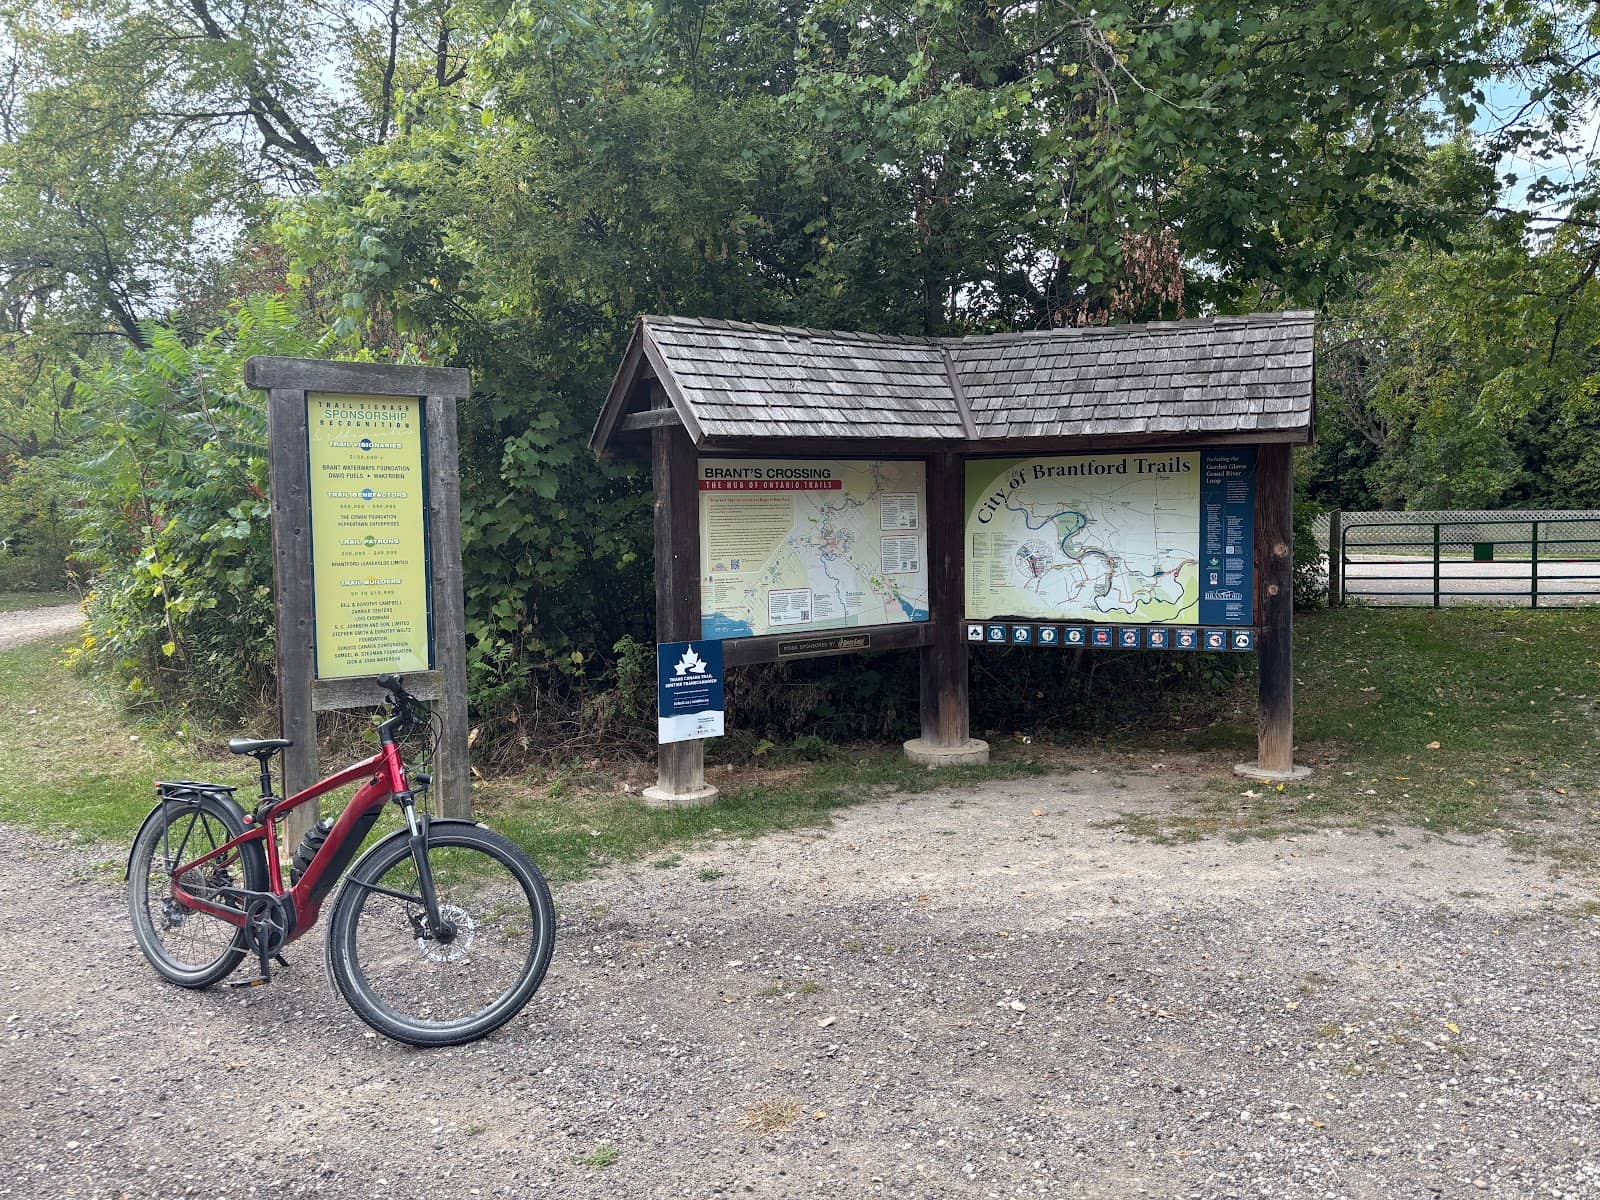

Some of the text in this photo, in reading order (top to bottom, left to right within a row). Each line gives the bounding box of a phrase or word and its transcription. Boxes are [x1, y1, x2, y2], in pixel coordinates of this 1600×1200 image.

[317, 401, 409, 411] TRAIL SIGNAGE
[324, 409, 408, 421] SPONSORSHIP
[319, 419, 410, 429] RECOGNITION
[353, 441, 402, 449] VISIONARIES
[704, 467, 832, 479] BRANT'S CROSSING
[705, 480, 833, 489] THE HUB OF ONTARIO TRAILS
[977, 456, 1191, 524] City of Brantford Trails
